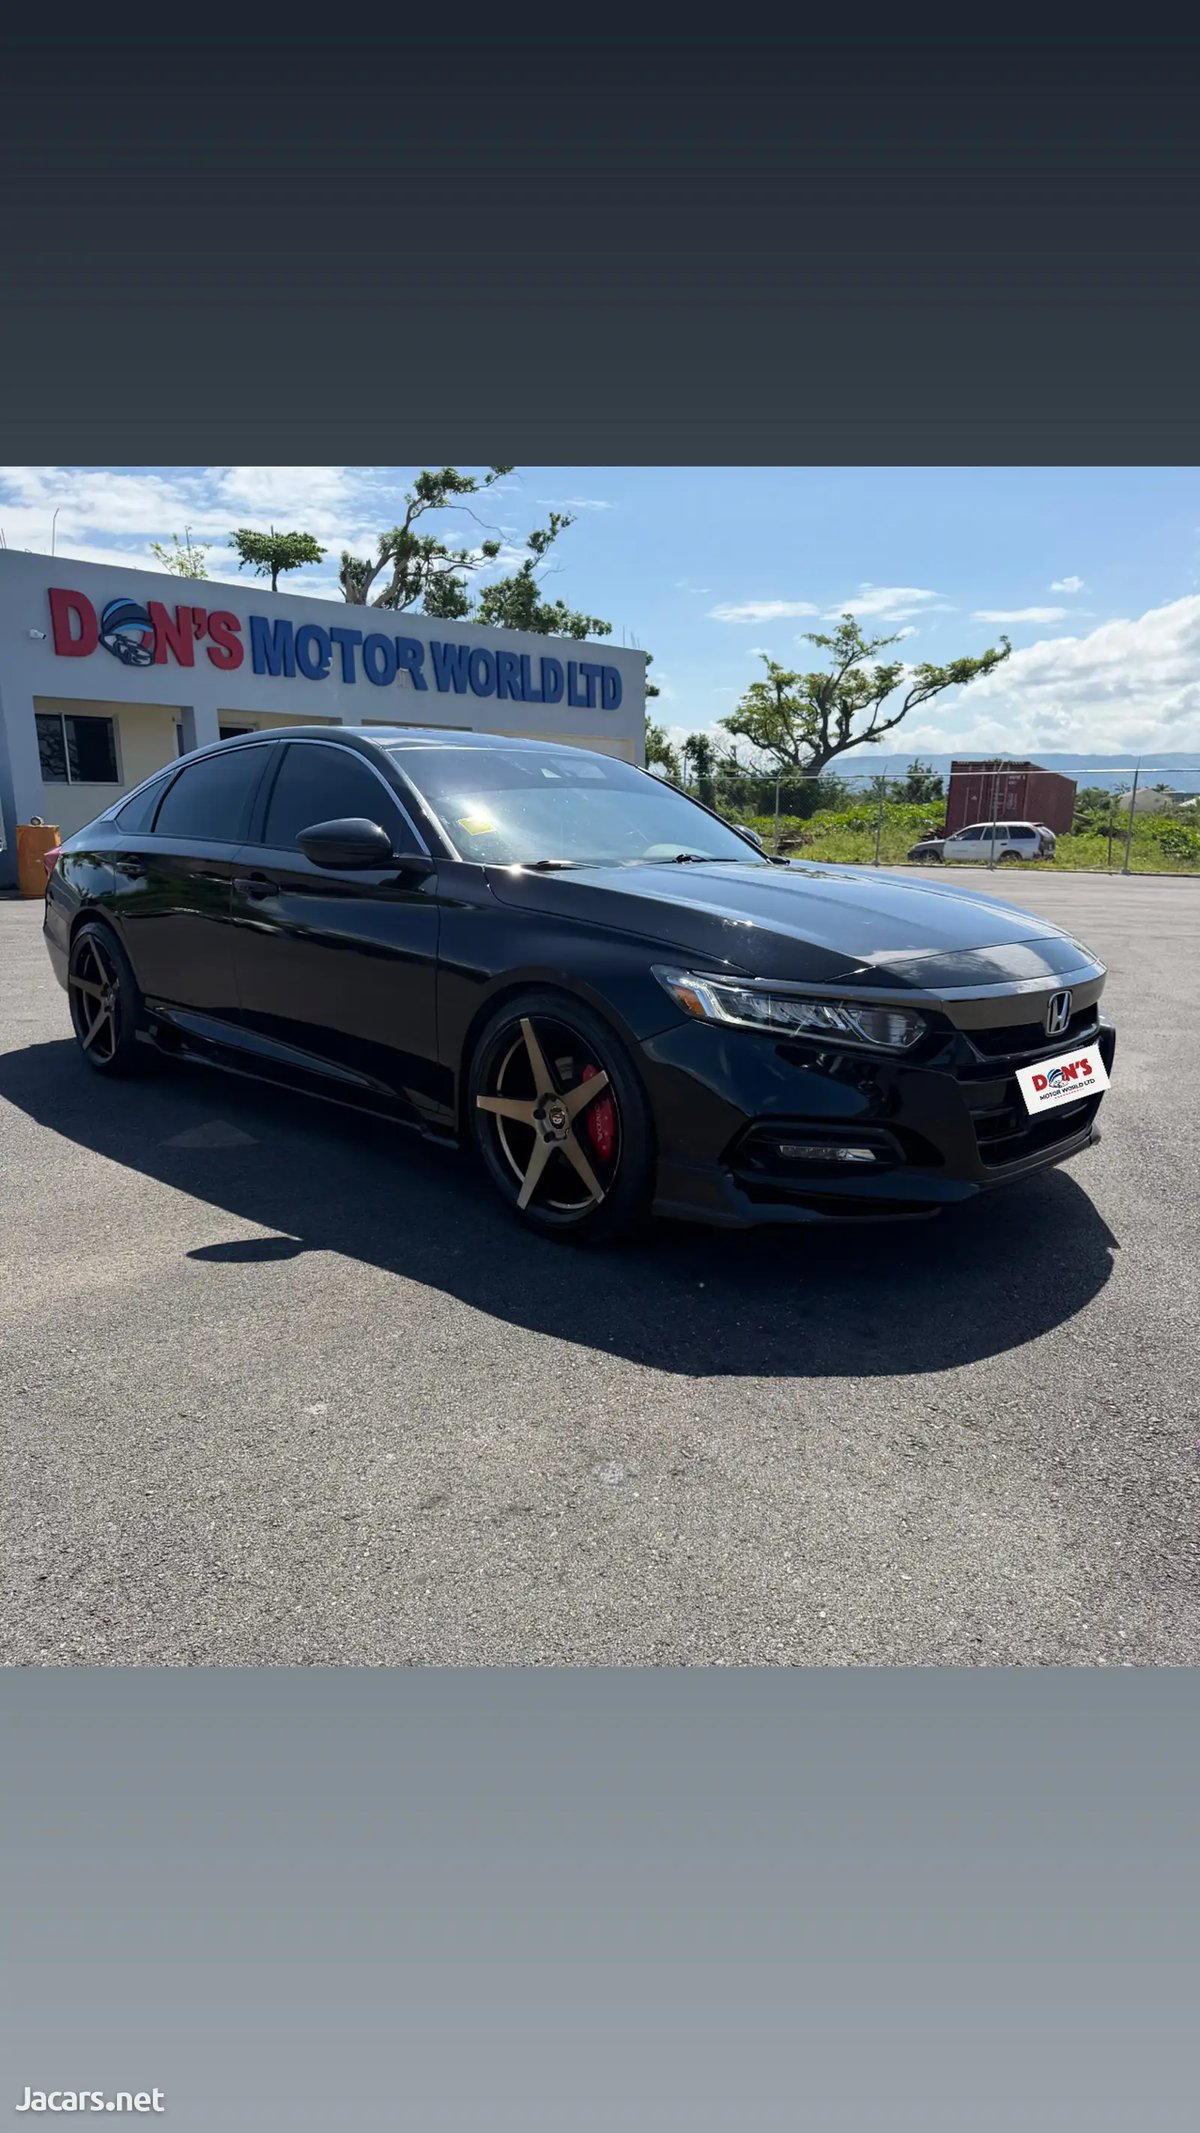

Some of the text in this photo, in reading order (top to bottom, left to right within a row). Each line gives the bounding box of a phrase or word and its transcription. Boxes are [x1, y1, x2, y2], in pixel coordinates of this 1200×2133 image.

[48, 587, 623, 710] DON'S MOTOR WORLD LTD
